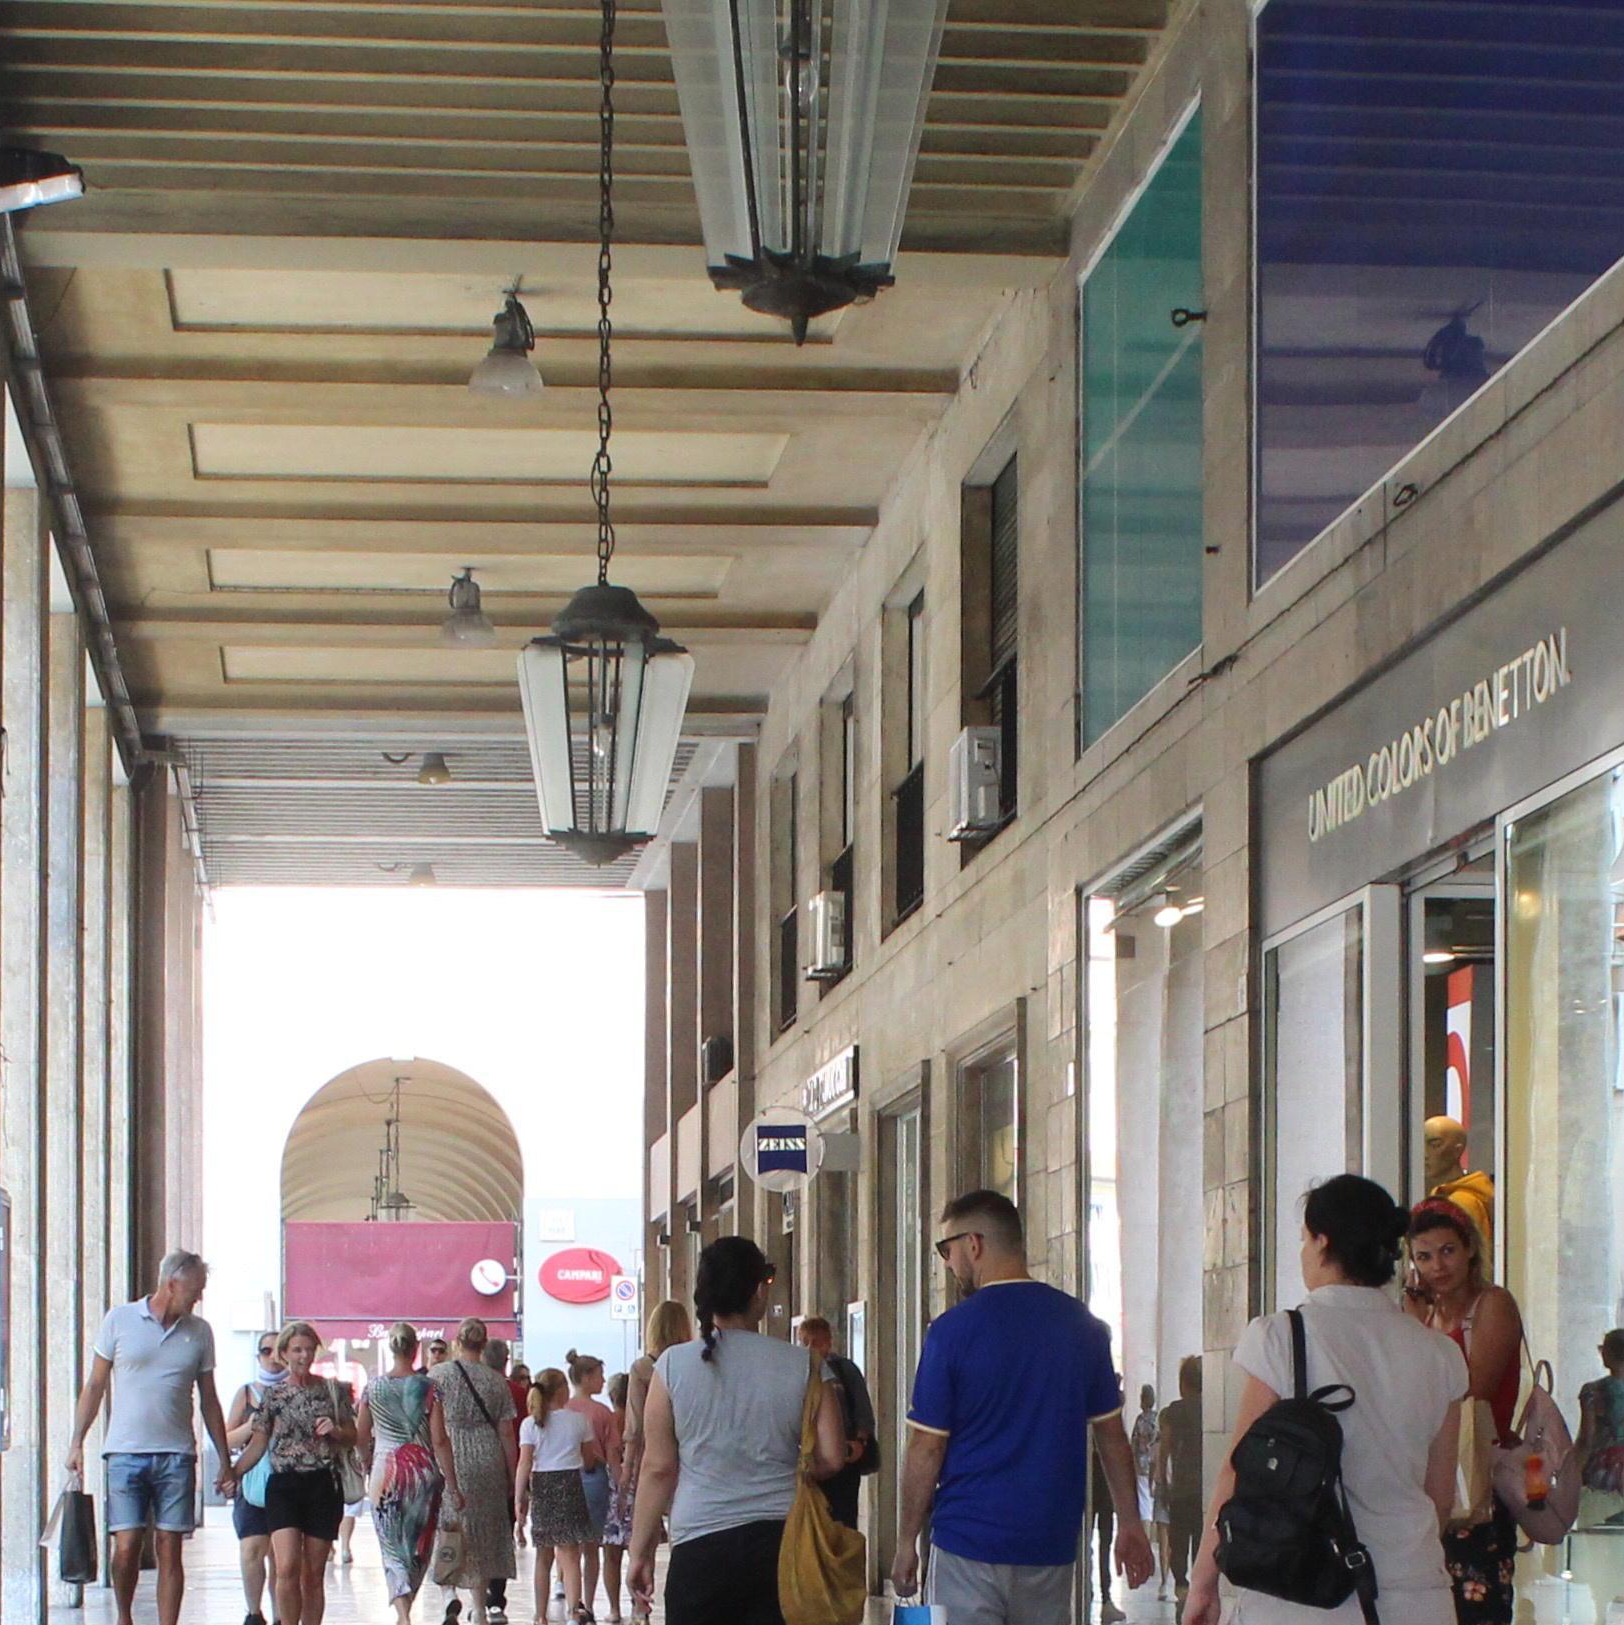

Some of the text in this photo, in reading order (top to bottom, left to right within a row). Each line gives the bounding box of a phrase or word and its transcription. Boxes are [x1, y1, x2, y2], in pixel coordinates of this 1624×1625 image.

[1308, 764, 1365, 842] UNITED
[1367, 717, 1434, 806] COLORS
[1435, 698, 1461, 765] OF
[758, 1137, 806, 1152] ZEISS
[557, 1269, 603, 1284] CAMPARI
